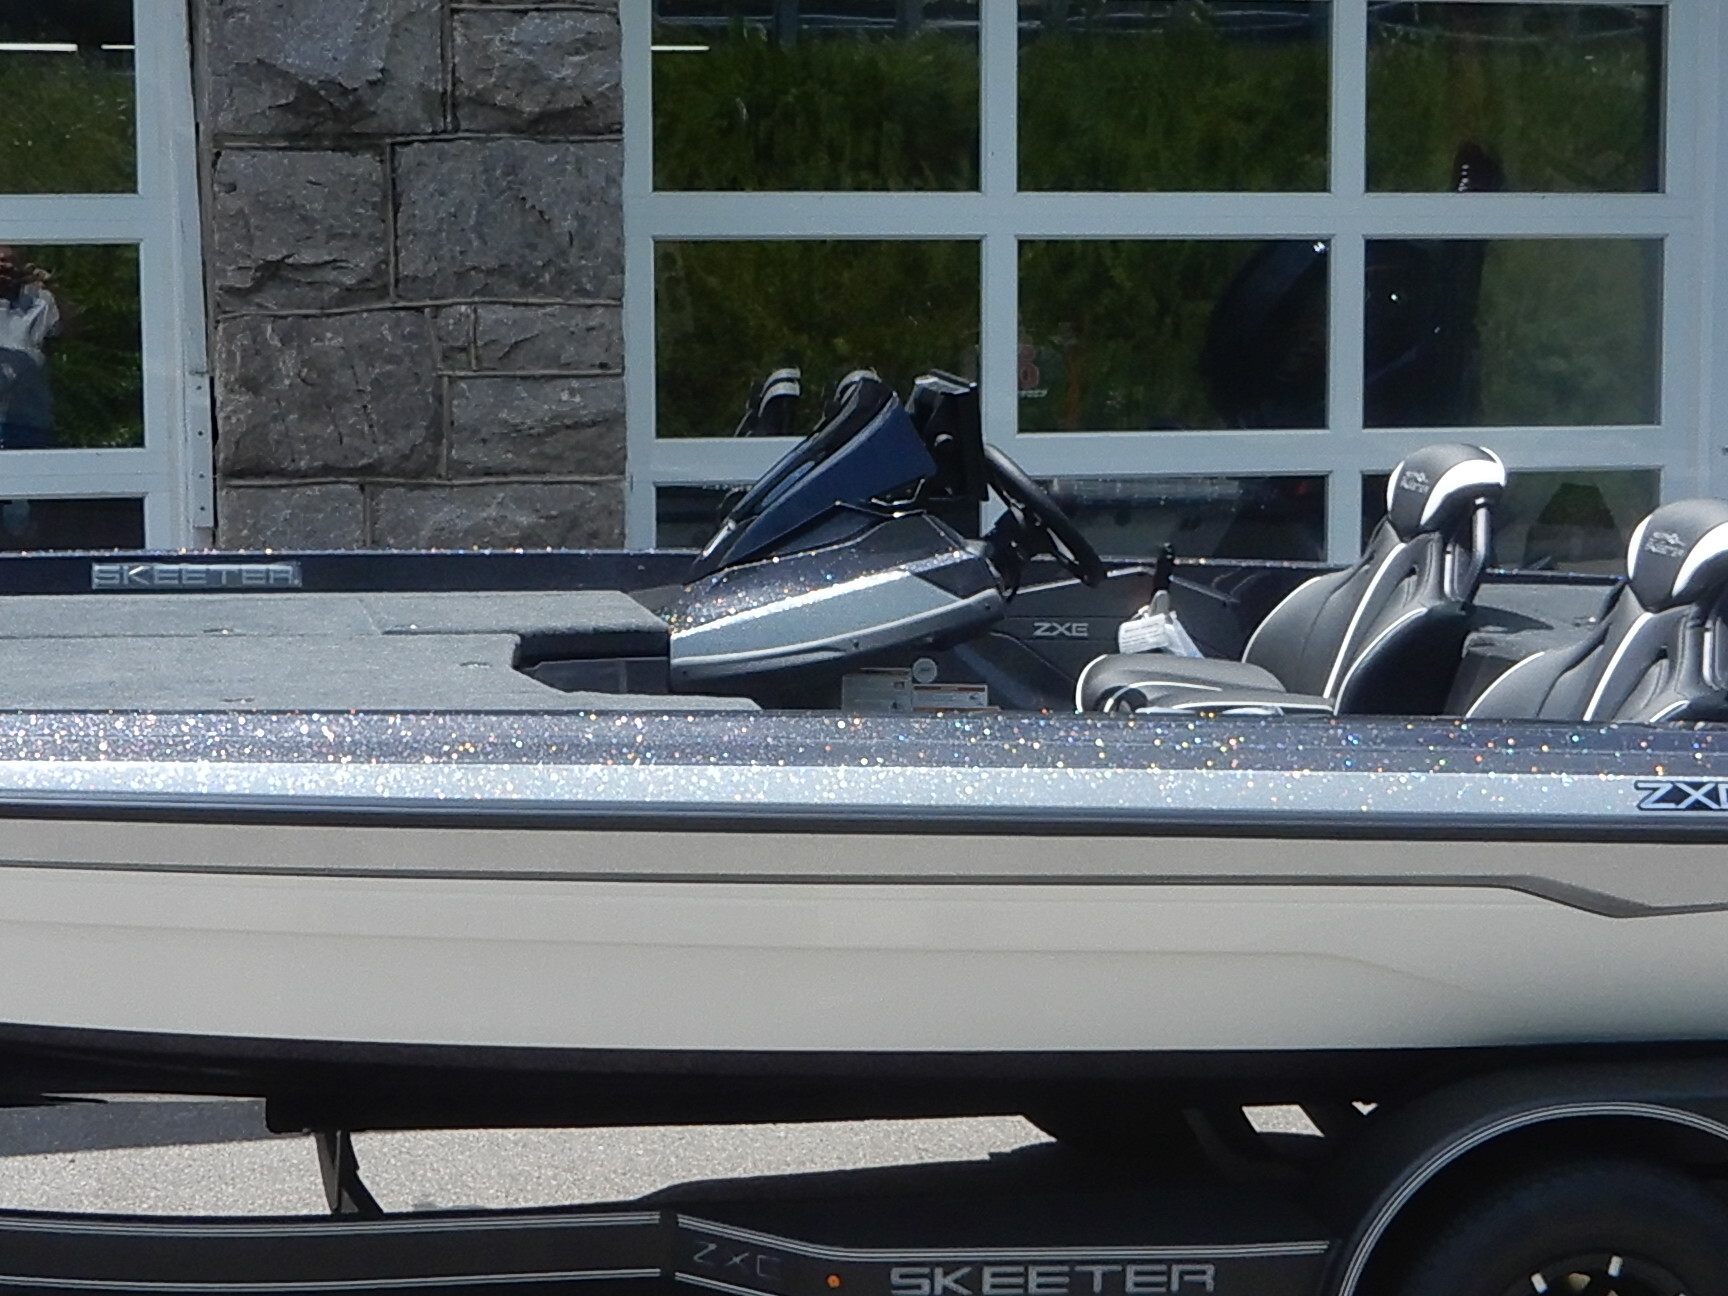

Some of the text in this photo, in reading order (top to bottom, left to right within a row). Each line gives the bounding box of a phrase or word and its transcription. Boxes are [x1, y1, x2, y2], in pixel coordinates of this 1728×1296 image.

[93, 563, 295, 586] SKEETER
[1032, 621, 1089, 637] ZXE
[889, 1263, 1217, 1296] SKEETER
